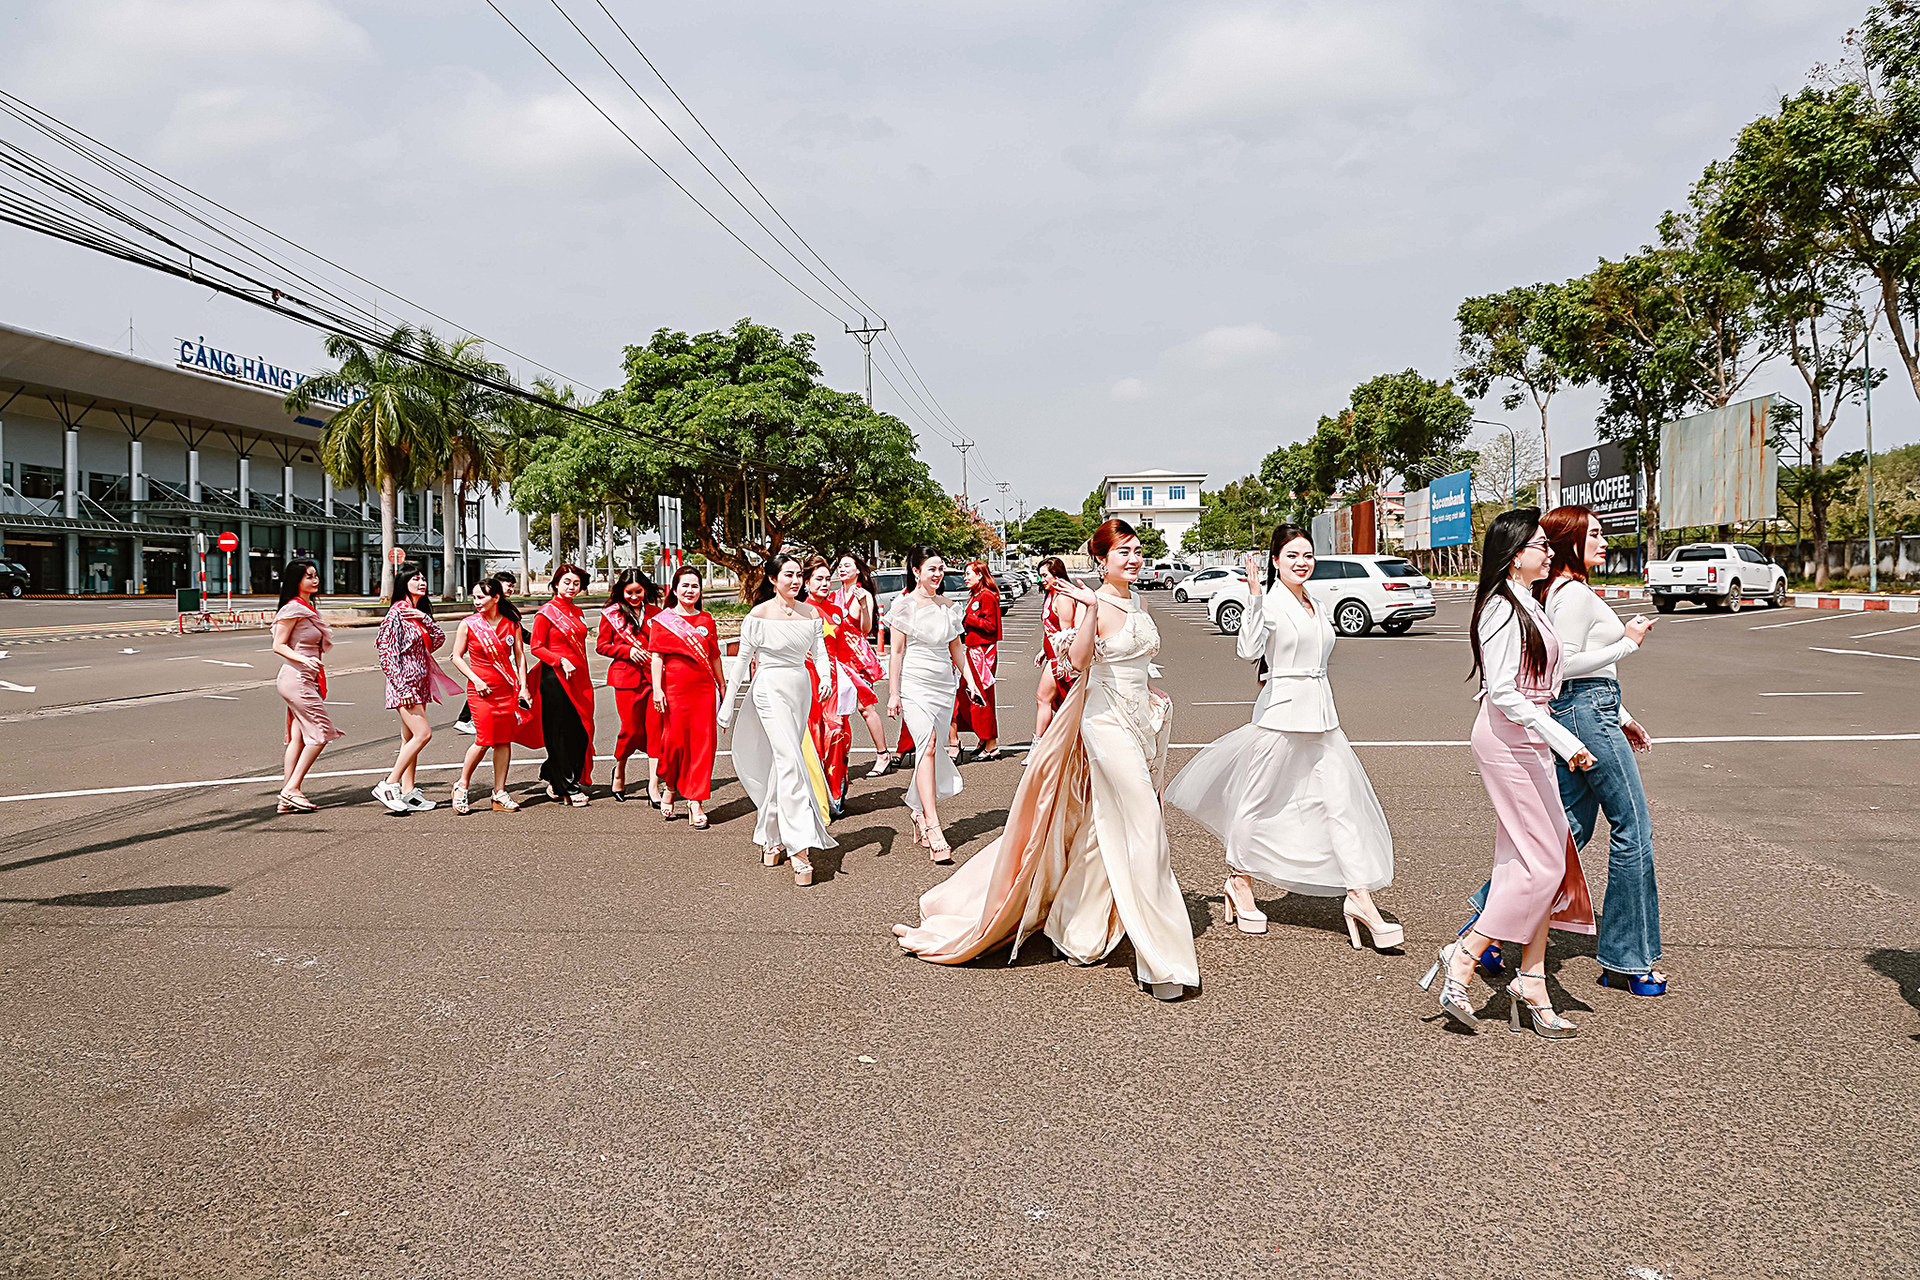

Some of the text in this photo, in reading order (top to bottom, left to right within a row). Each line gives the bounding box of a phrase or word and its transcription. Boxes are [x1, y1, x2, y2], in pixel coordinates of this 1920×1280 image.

[180, 335, 237, 375] CẢNG
[243, 355, 292, 390] HÀNG
[1432, 488, 1465, 510] Sacombank
[1562, 486, 1578, 506] THU
[1593, 475, 1630, 502] COFFEE
